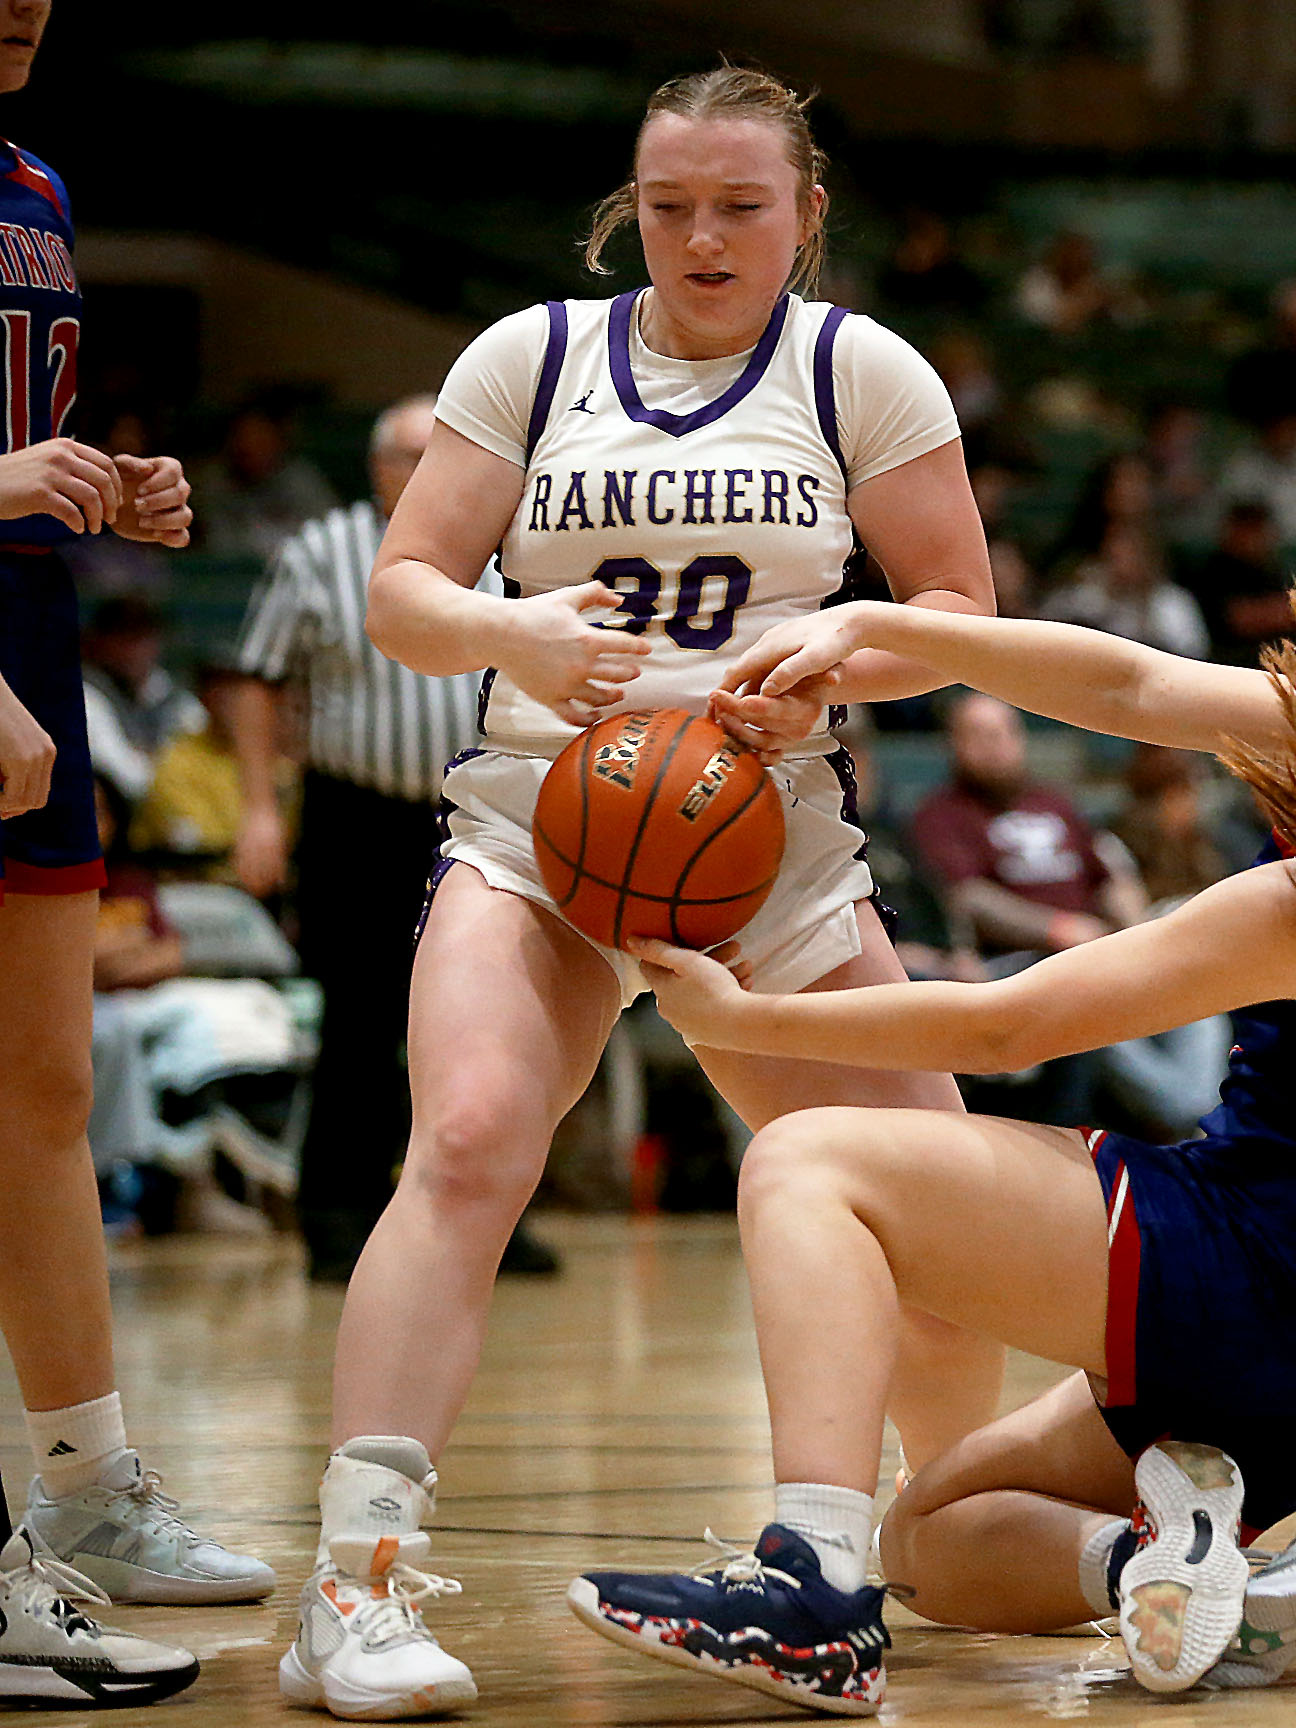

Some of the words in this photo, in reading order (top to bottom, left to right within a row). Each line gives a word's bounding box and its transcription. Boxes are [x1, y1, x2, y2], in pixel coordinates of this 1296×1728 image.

[0, 310, 80, 455] 12
[528, 468, 821, 532] RANCHERS
[589, 552, 757, 653] 30
